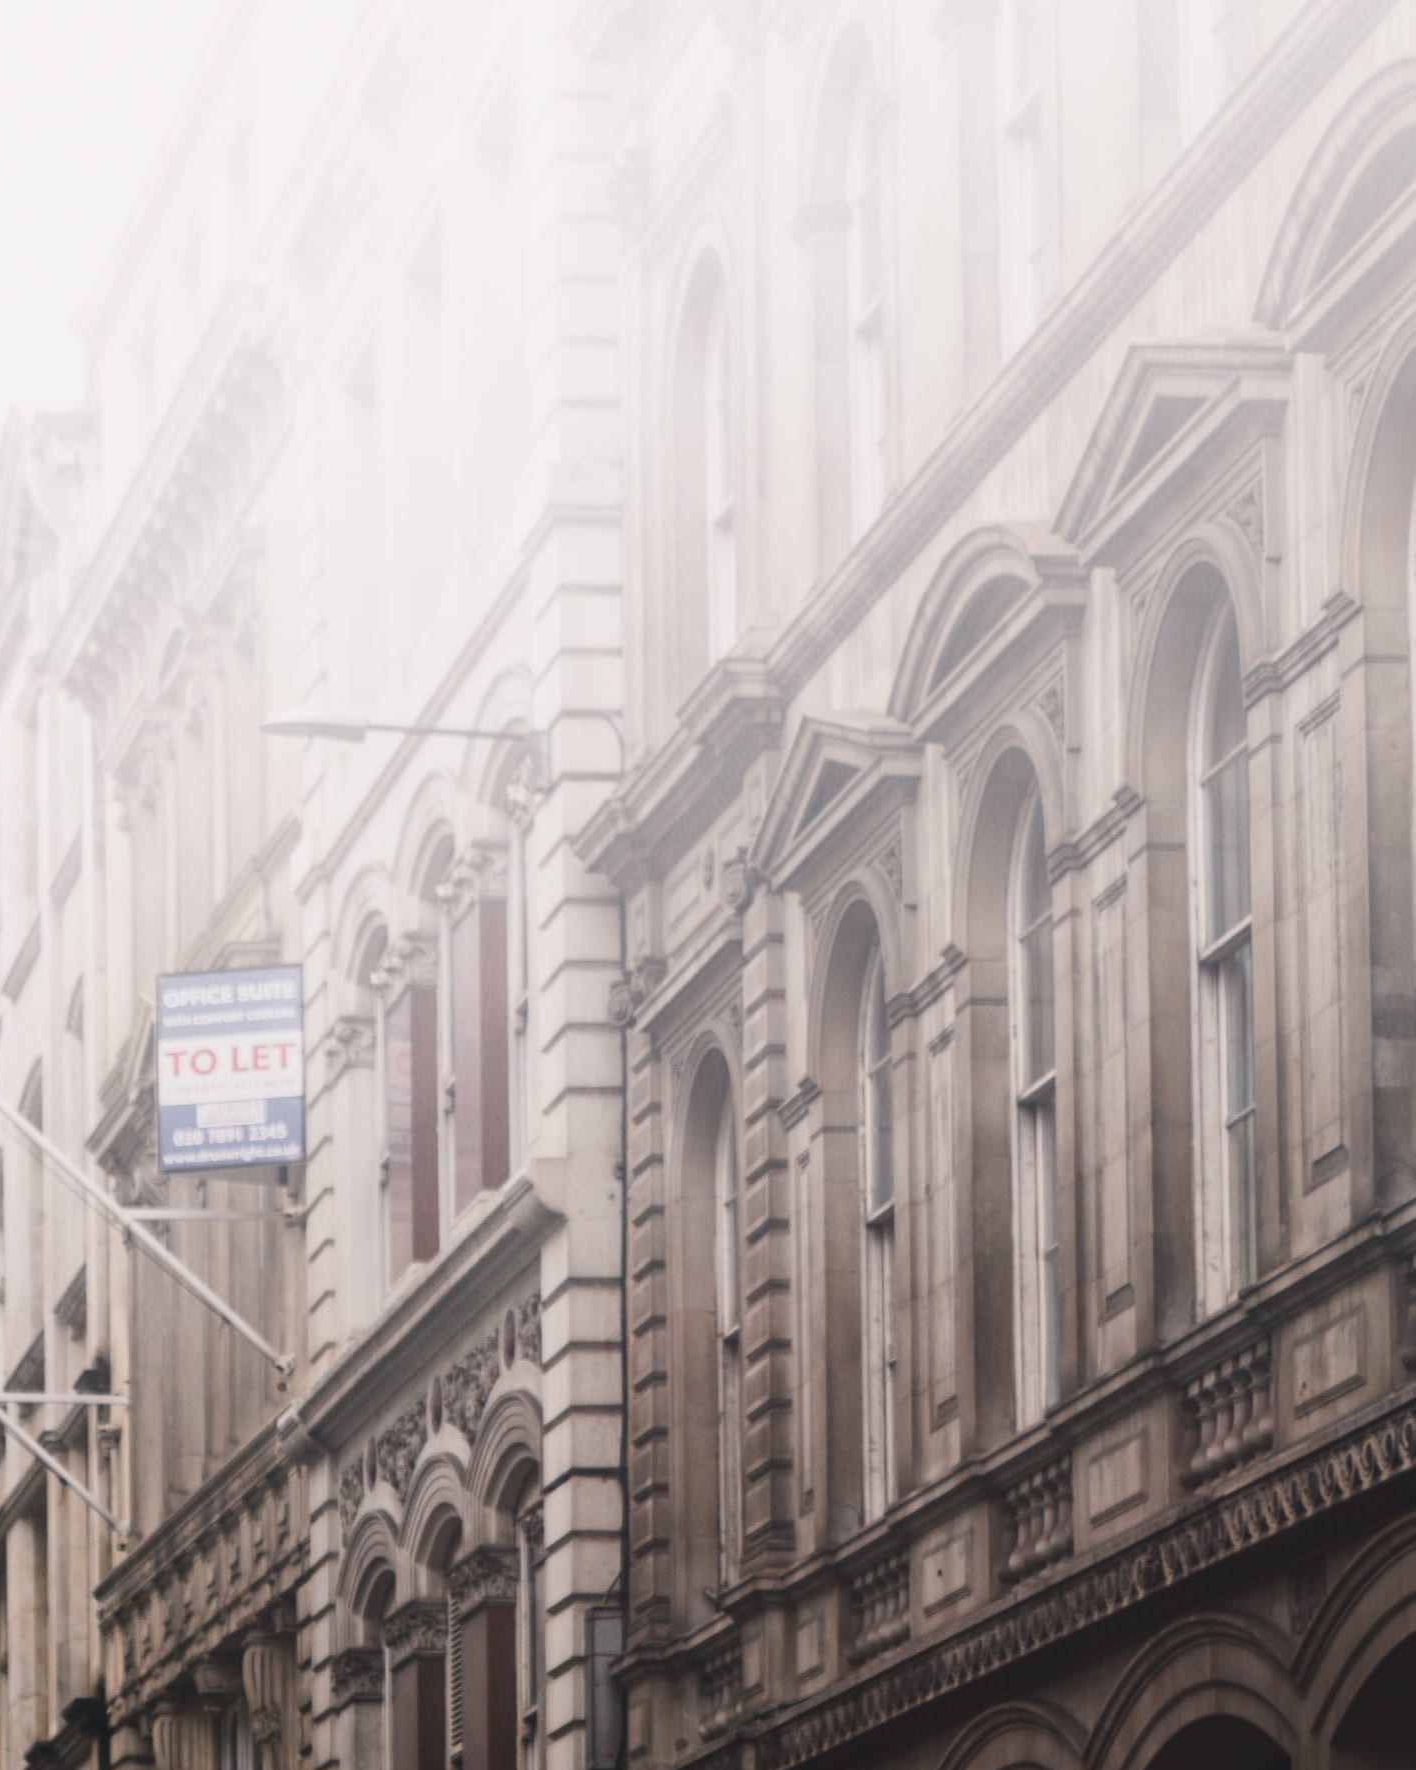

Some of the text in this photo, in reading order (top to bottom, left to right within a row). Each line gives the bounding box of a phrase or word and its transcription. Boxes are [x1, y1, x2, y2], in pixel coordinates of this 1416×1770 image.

[163, 979, 298, 1008] OFFICE SUITE
[164, 1042, 296, 1077] TO LET
